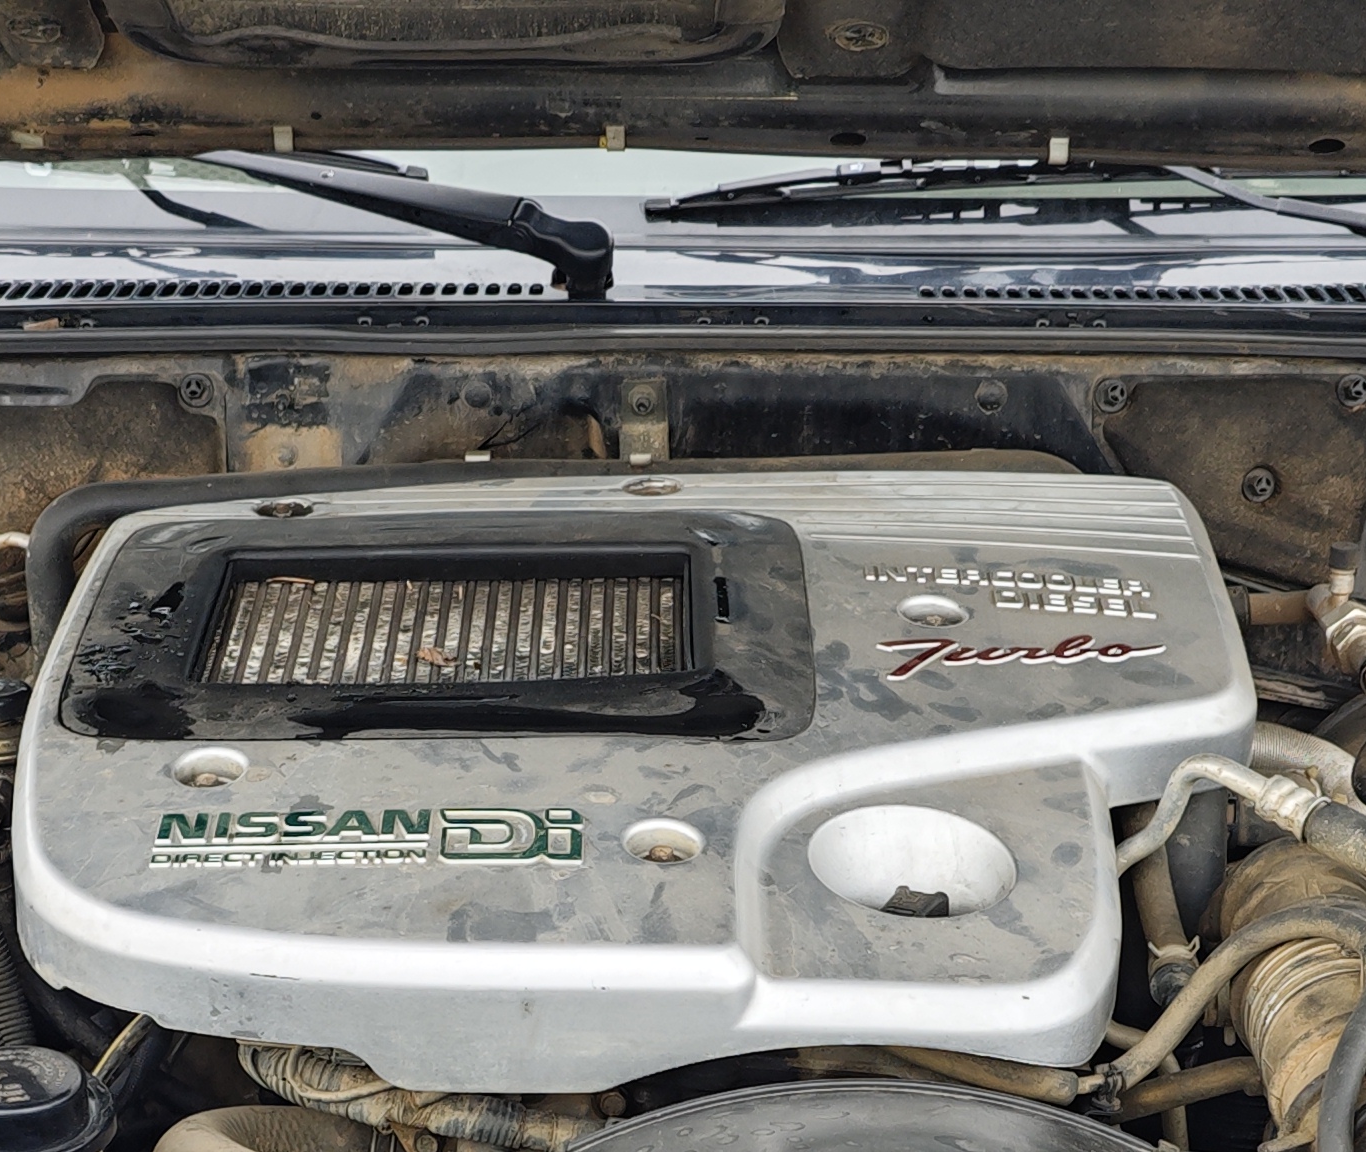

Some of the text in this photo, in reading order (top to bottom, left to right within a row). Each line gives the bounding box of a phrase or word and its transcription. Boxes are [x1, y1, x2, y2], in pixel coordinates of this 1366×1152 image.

[863, 565, 1151, 597] INTERCOOLER
[994, 589, 1158, 619] DIESEL
[875, 634, 1167, 681] Turbo
[154, 808, 433, 845] NISSAN
